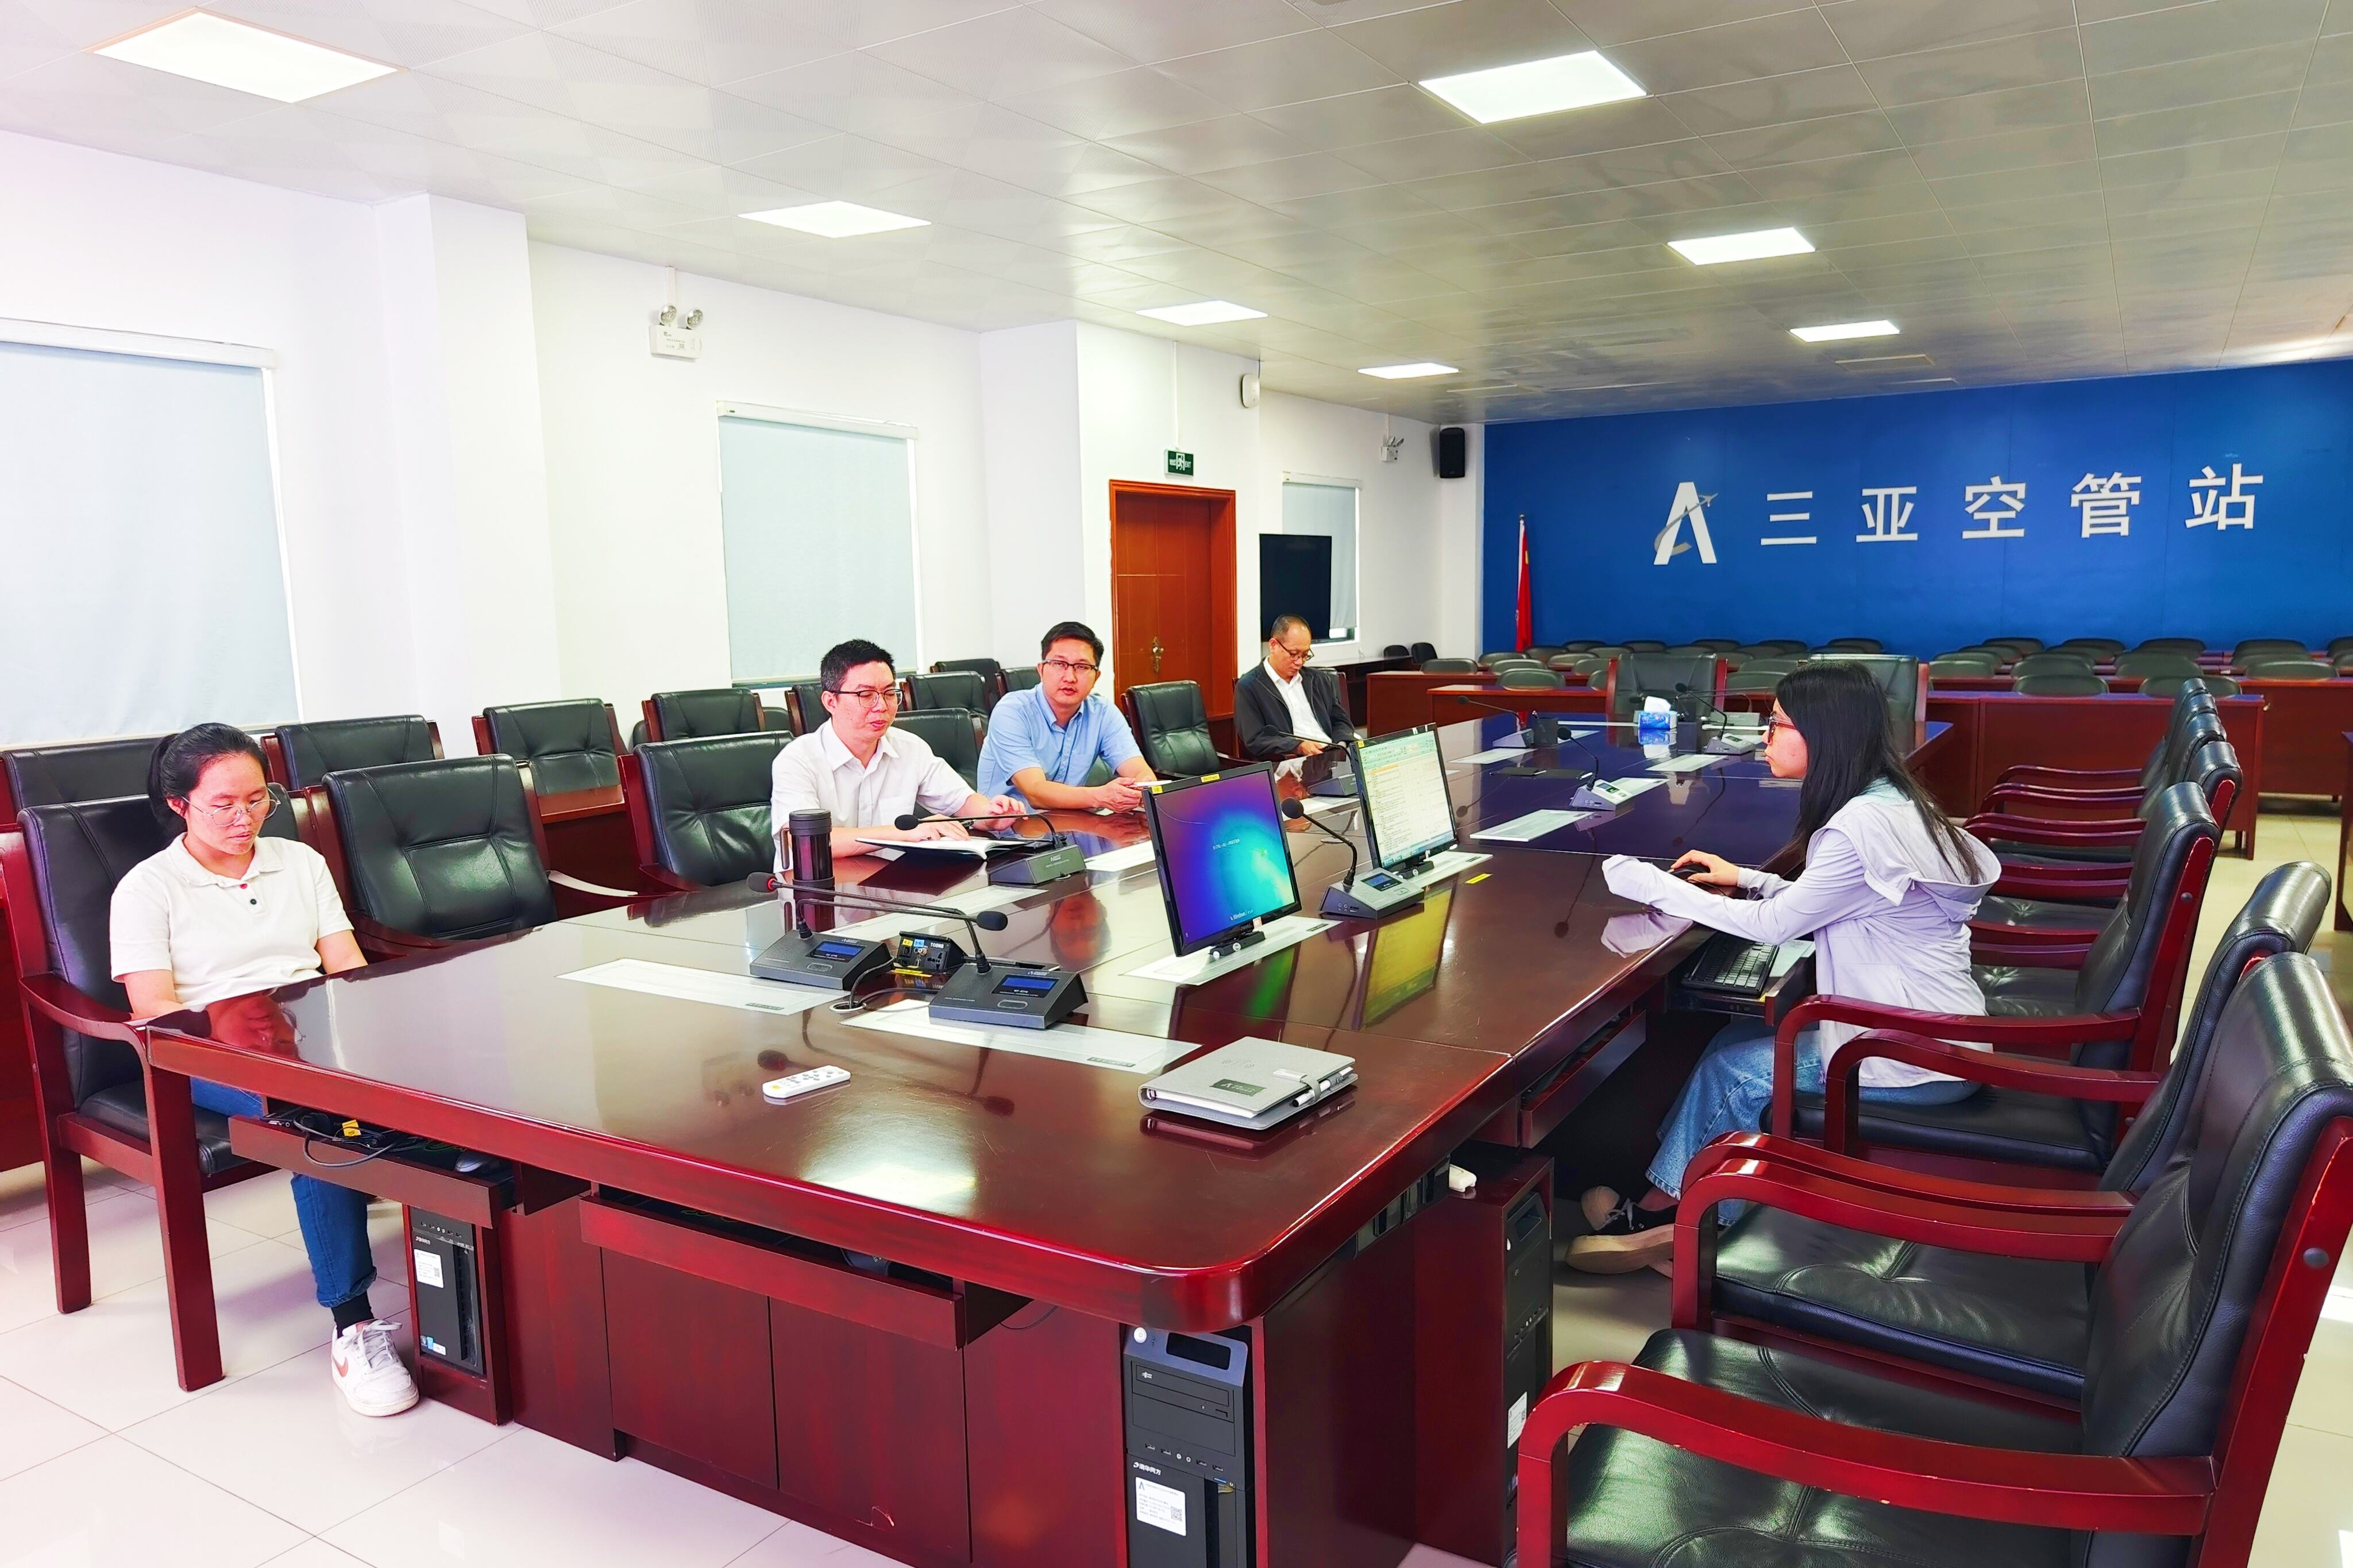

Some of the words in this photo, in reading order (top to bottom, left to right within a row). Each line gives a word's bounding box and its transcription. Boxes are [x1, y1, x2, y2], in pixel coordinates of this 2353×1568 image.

[1760, 463, 2263, 546] 三亚空管站
